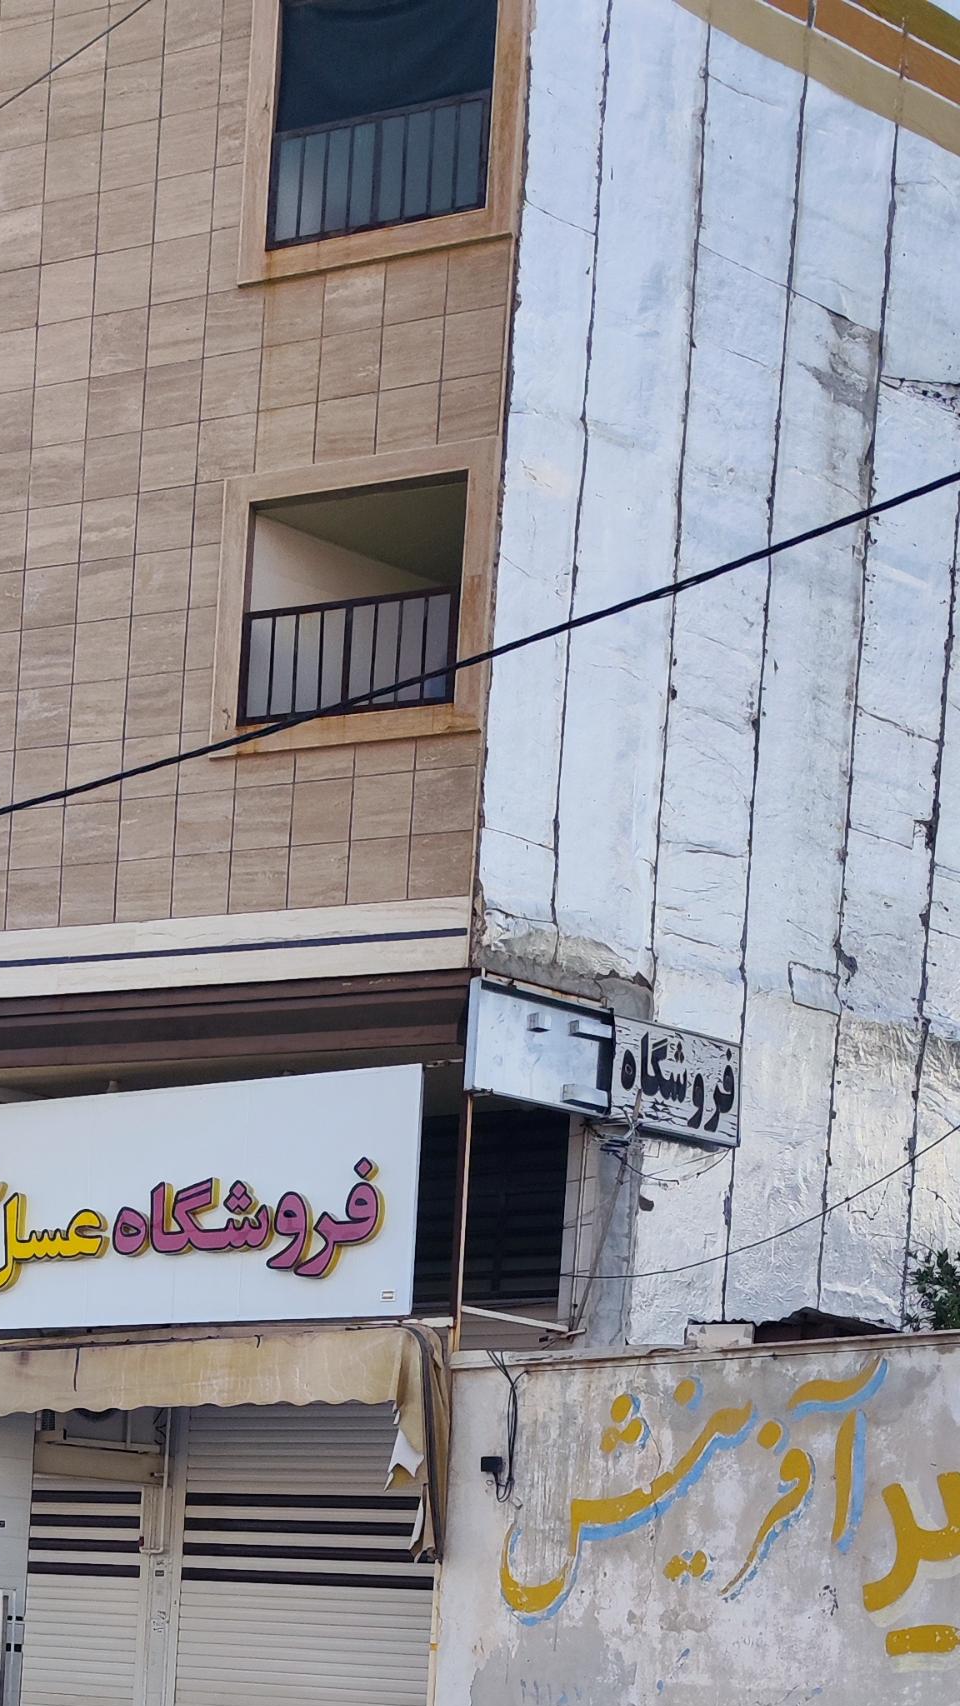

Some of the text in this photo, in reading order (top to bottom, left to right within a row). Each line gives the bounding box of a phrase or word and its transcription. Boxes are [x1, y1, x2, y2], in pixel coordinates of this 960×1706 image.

[620, 1031, 735, 1133] فروشگاه
[112, 1157, 385, 1279] فروشگاه
[499, 1354, 889, 1626] آفرینش
